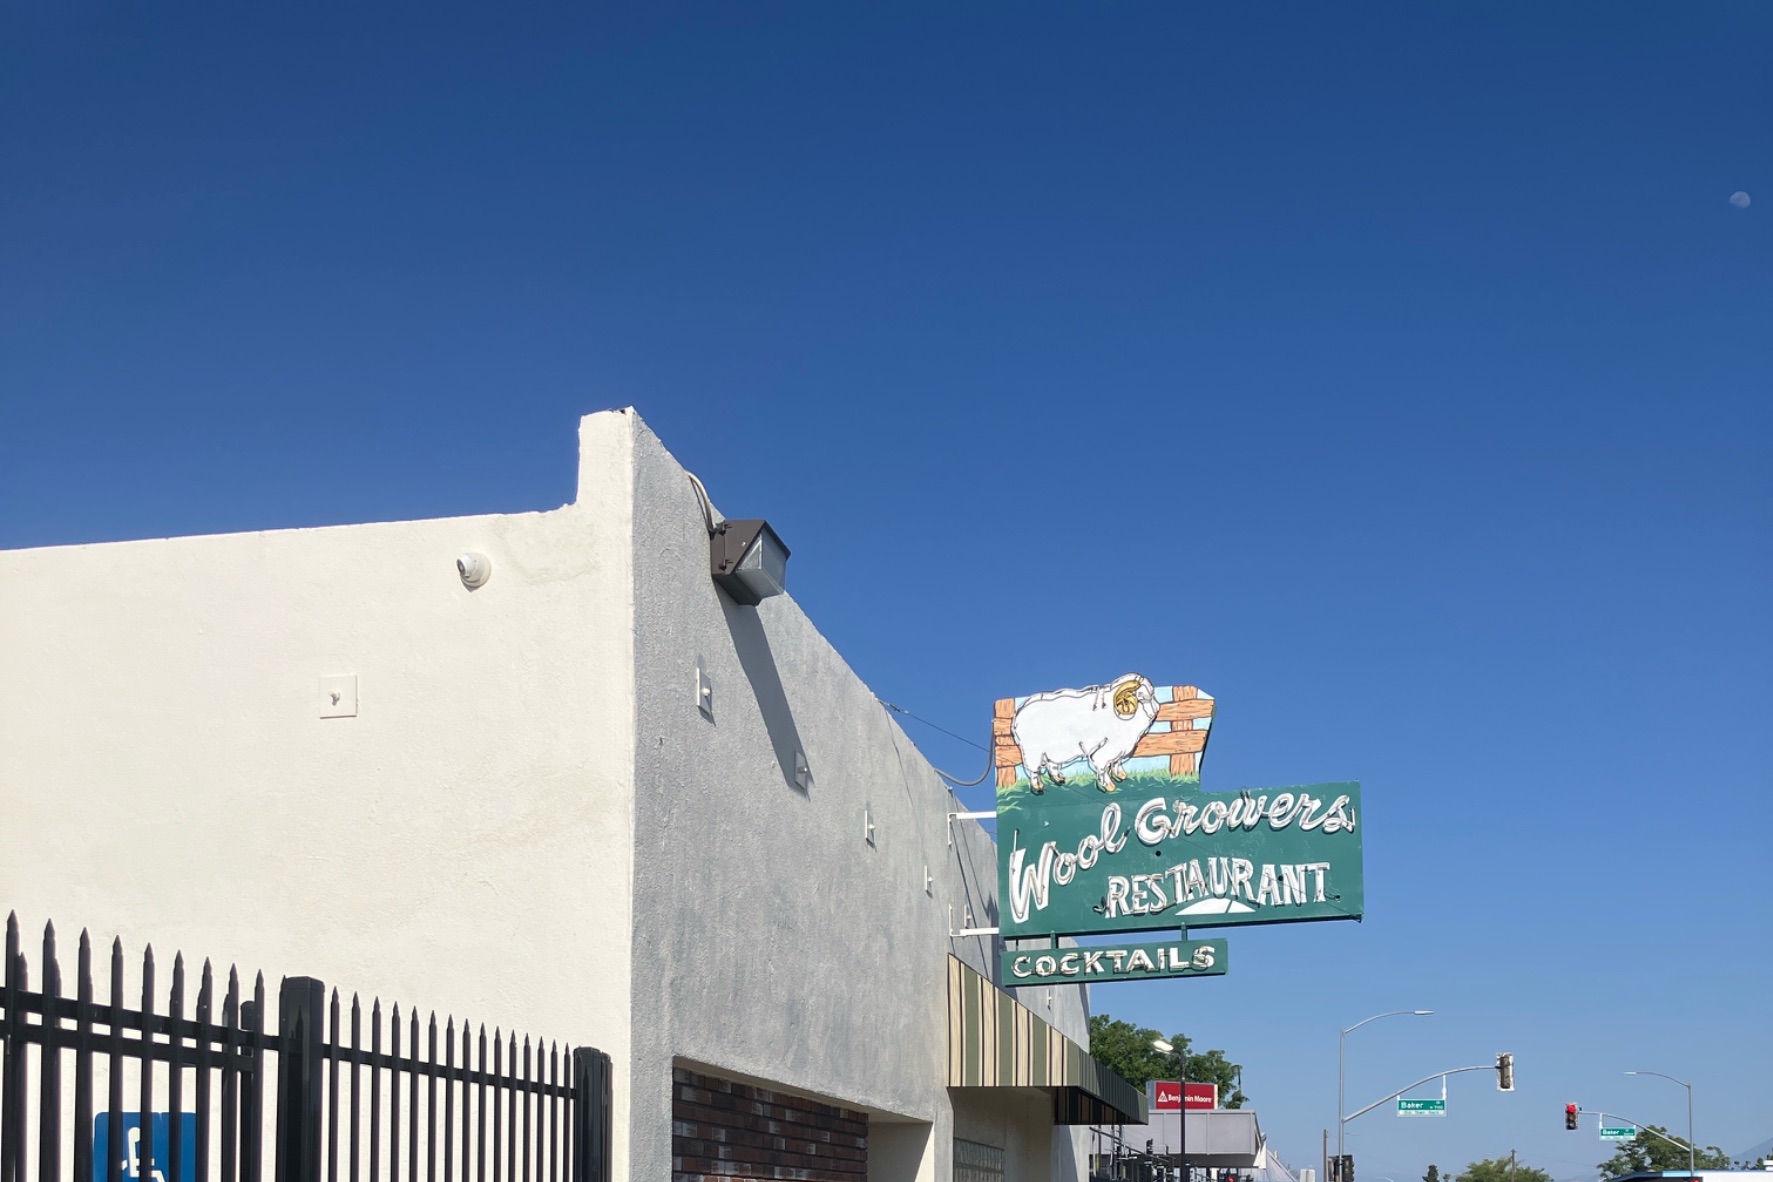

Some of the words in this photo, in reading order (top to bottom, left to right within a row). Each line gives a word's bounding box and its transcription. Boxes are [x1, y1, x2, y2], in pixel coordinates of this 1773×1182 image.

[1009, 803, 1129, 924] Wool
[1135, 792, 1356, 845] Growers
[1105, 856, 1331, 918] RESTAURANT
[1011, 945, 1216, 978] COCKTAILS
[1168, 1094, 1194, 1104] Benjmin
[1401, 1101, 1423, 1109] Baker
